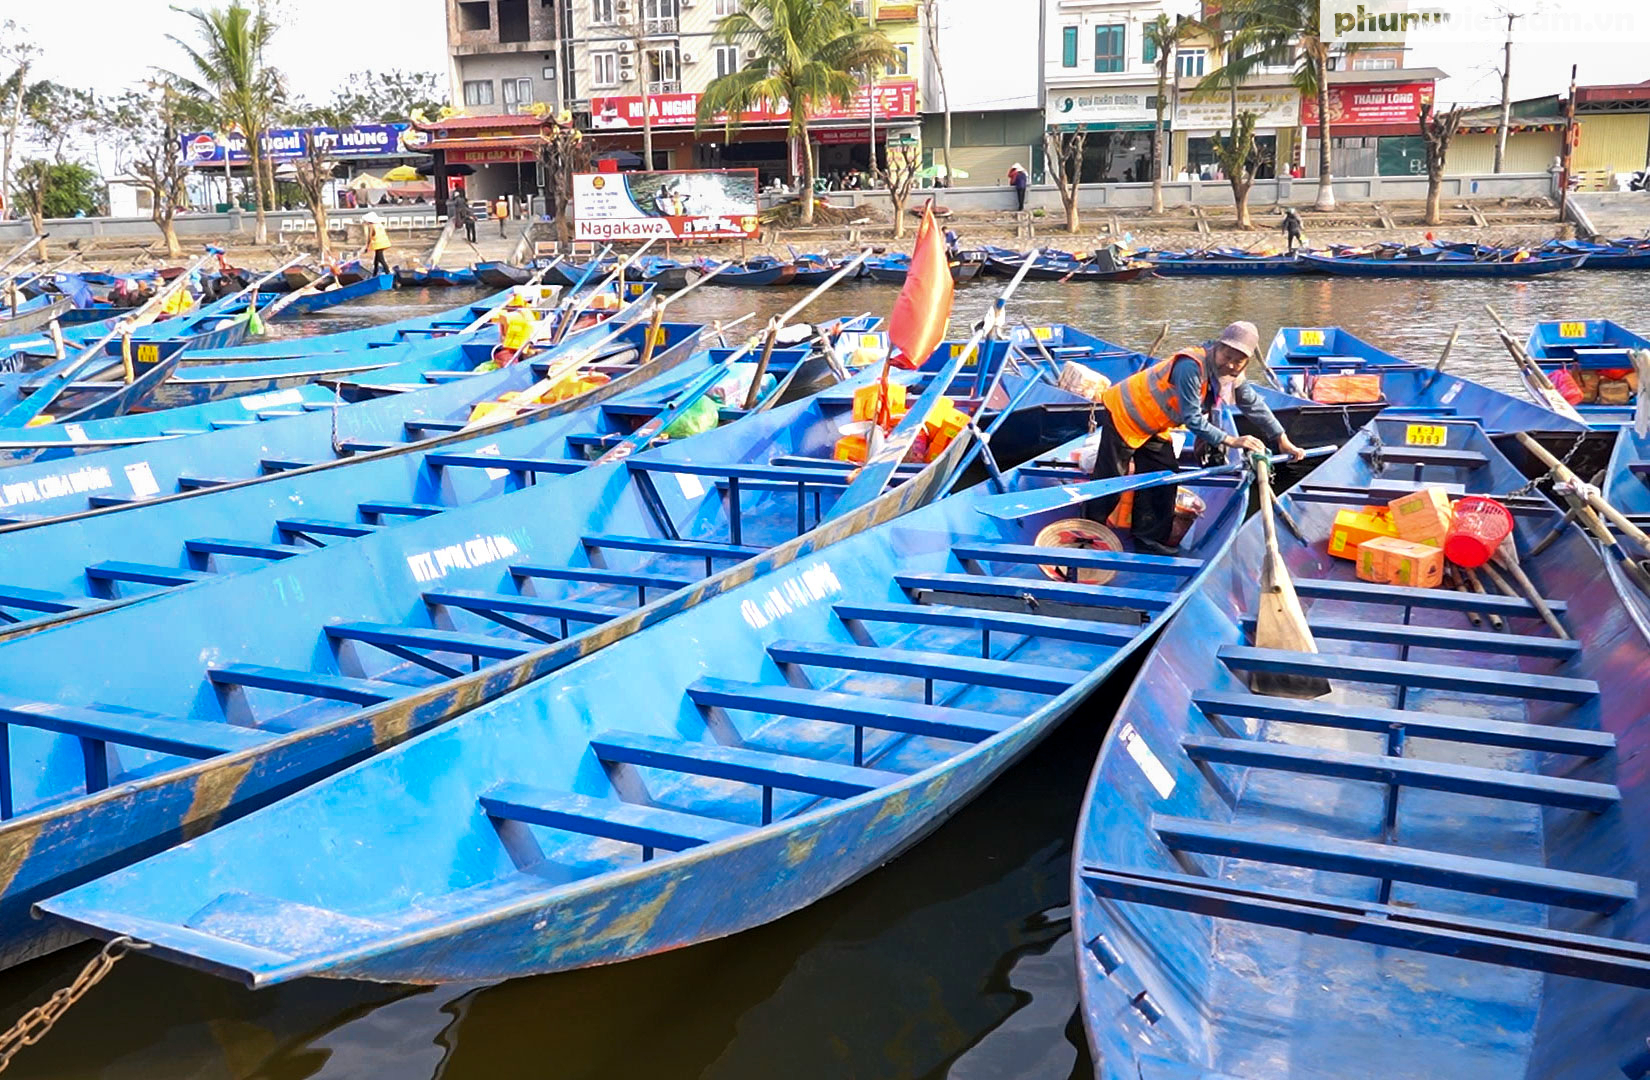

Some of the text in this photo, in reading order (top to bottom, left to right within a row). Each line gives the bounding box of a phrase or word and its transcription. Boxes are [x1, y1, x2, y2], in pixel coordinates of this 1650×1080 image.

[1354, 93, 1413, 105] THANH LONG
[341, 129, 388, 147] HÙNG
